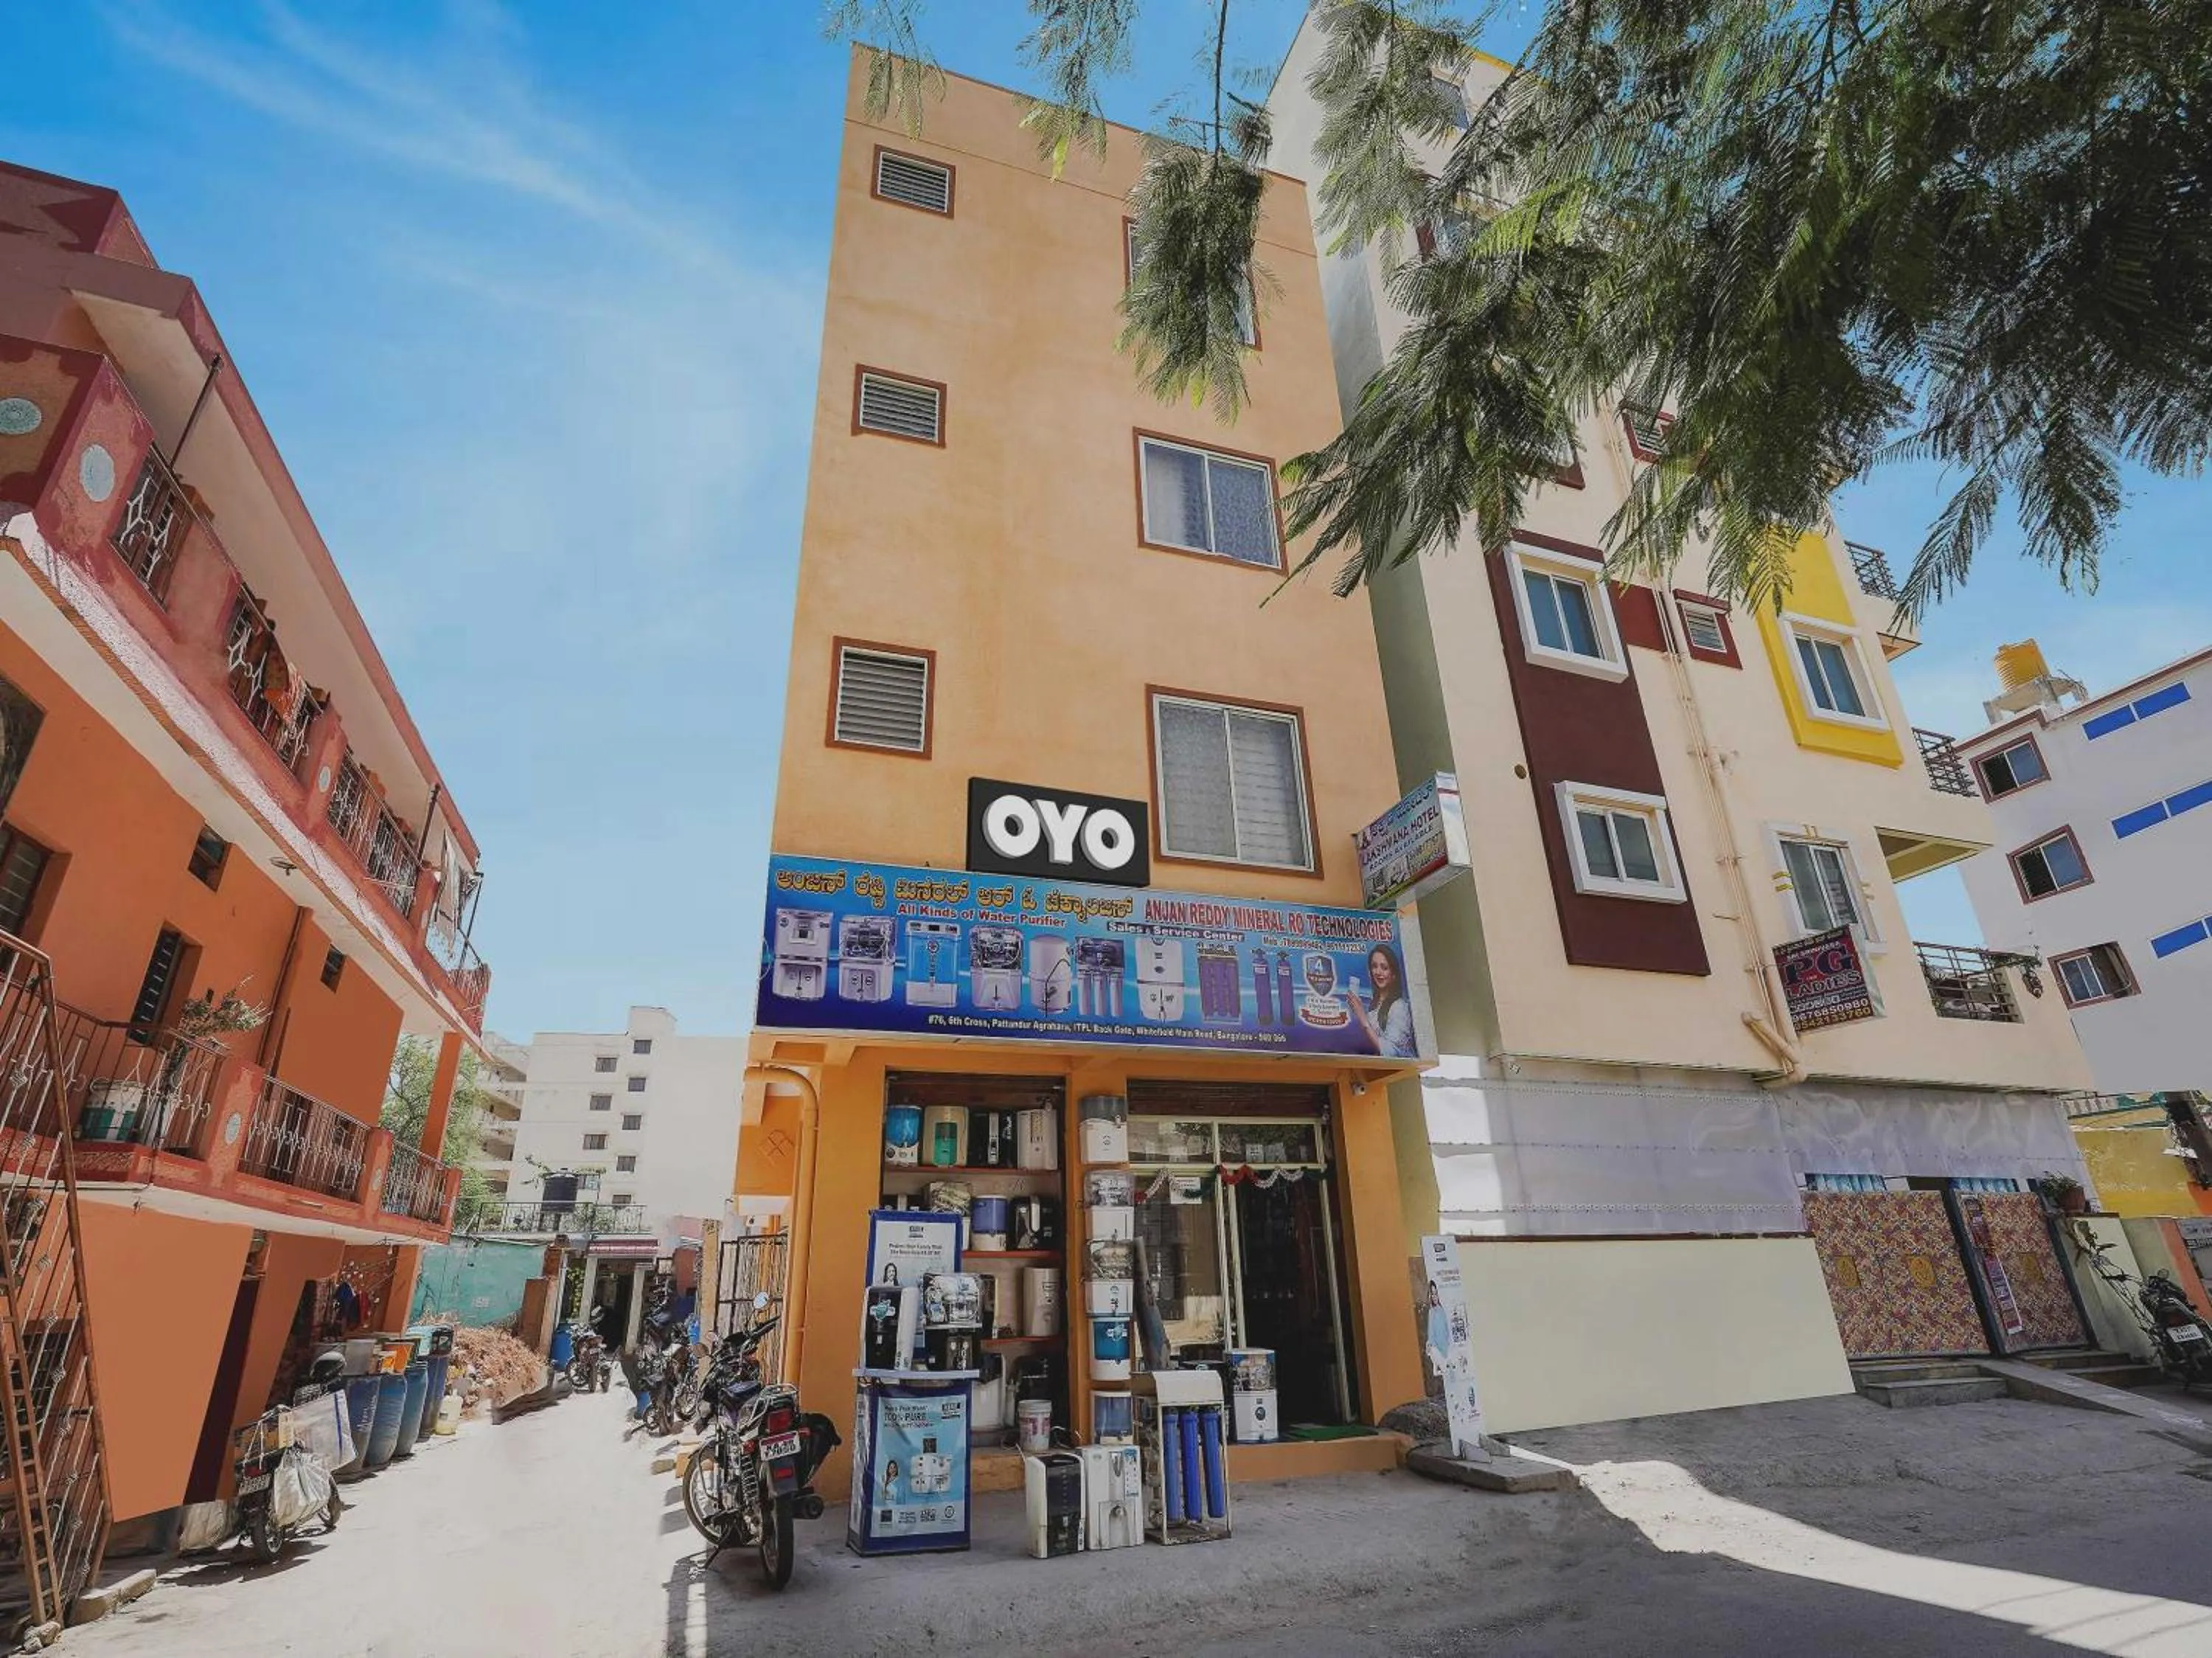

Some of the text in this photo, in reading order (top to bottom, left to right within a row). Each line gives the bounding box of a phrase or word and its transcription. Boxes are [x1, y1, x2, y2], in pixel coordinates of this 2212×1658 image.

[983, 794, 1135, 870] OYO
[1411, 805, 1439, 832] HOTEL
[898, 903, 1065, 927] All Kinds of Water Purifier
[1145, 898, 1186, 923] ANJAN
[1189, 903, 1229, 926] REDDY
[1232, 906, 1285, 933] MINERAL
[1306, 914, 1393, 942] TECHNOLOGIES
[1108, 923, 1142, 934] Sales
[1153, 926, 1200, 938] Service
[1203, 930, 1245, 942] Center
[1783, 943, 1854, 986] PG
[1786, 970, 1863, 998] LADIES
